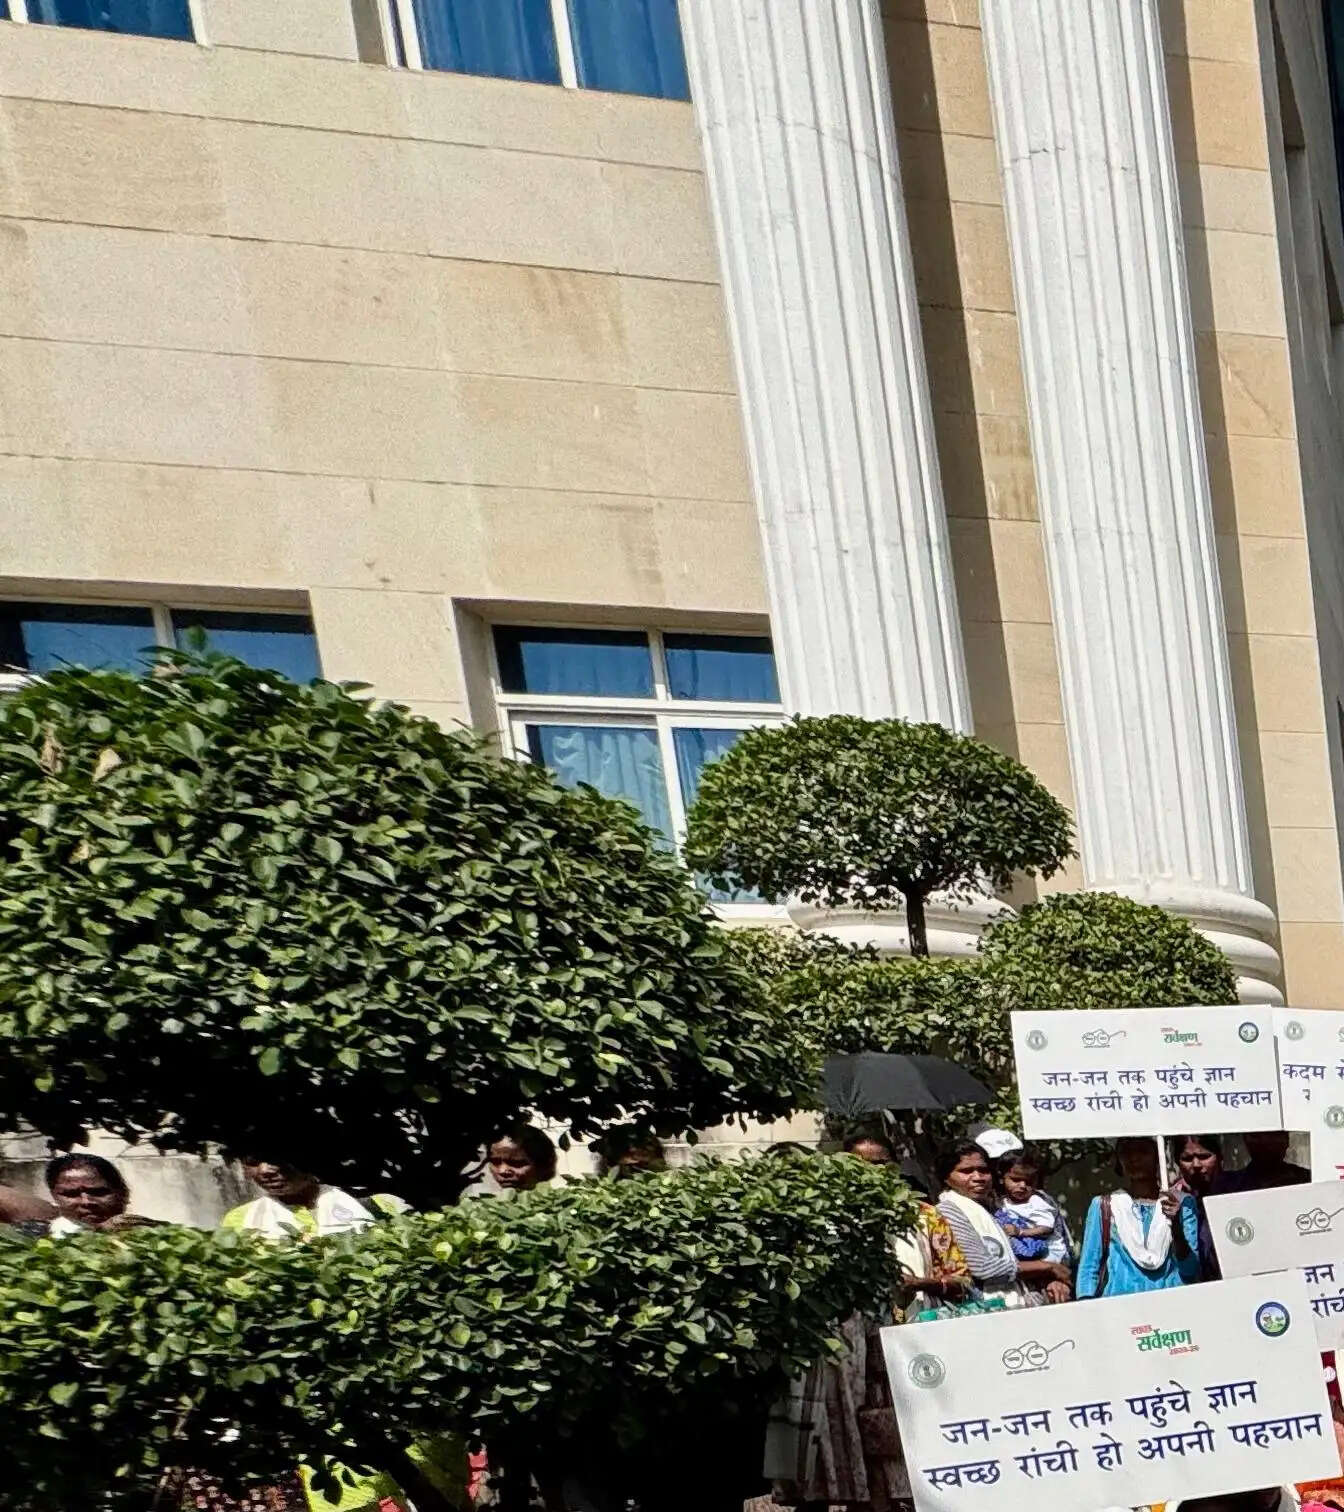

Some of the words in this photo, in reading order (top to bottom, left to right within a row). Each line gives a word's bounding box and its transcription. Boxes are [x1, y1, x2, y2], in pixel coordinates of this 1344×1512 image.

[1041, 1069, 1108, 1087] जन-जन
[1118, 1068, 1145, 1085] तक
[1154, 1061, 1194, 1089] पहुंचे
[1203, 1066, 1236, 1083] ज्ञान
[1282, 1063, 1326, 1080] कदम
[1029, 1096, 1077, 1113] स्वच्छ
[1084, 1089, 1124, 1113] रांची
[1130, 1088, 1149, 1112] हो
[1158, 1087, 1210, 1109] अपनी
[1215, 1090, 1273, 1108] पहचान
[1136, 1327, 1194, 1353] सर्वेक्षण
[940, 1408, 1052, 1447] जन-जन
[1065, 1401, 1113, 1430] तक
[1125, 1380, 1192, 1428] पहुंचे
[1203, 1380, 1257, 1413] ज्ञान
[923, 1460, 1001, 1492] स्वच्छ
[1014, 1440, 1080, 1479] रांची
[1096, 1433, 1123, 1474] हो
[1137, 1421, 1216, 1461] अपनी
[1228, 1412, 1324, 1449] पहचान
